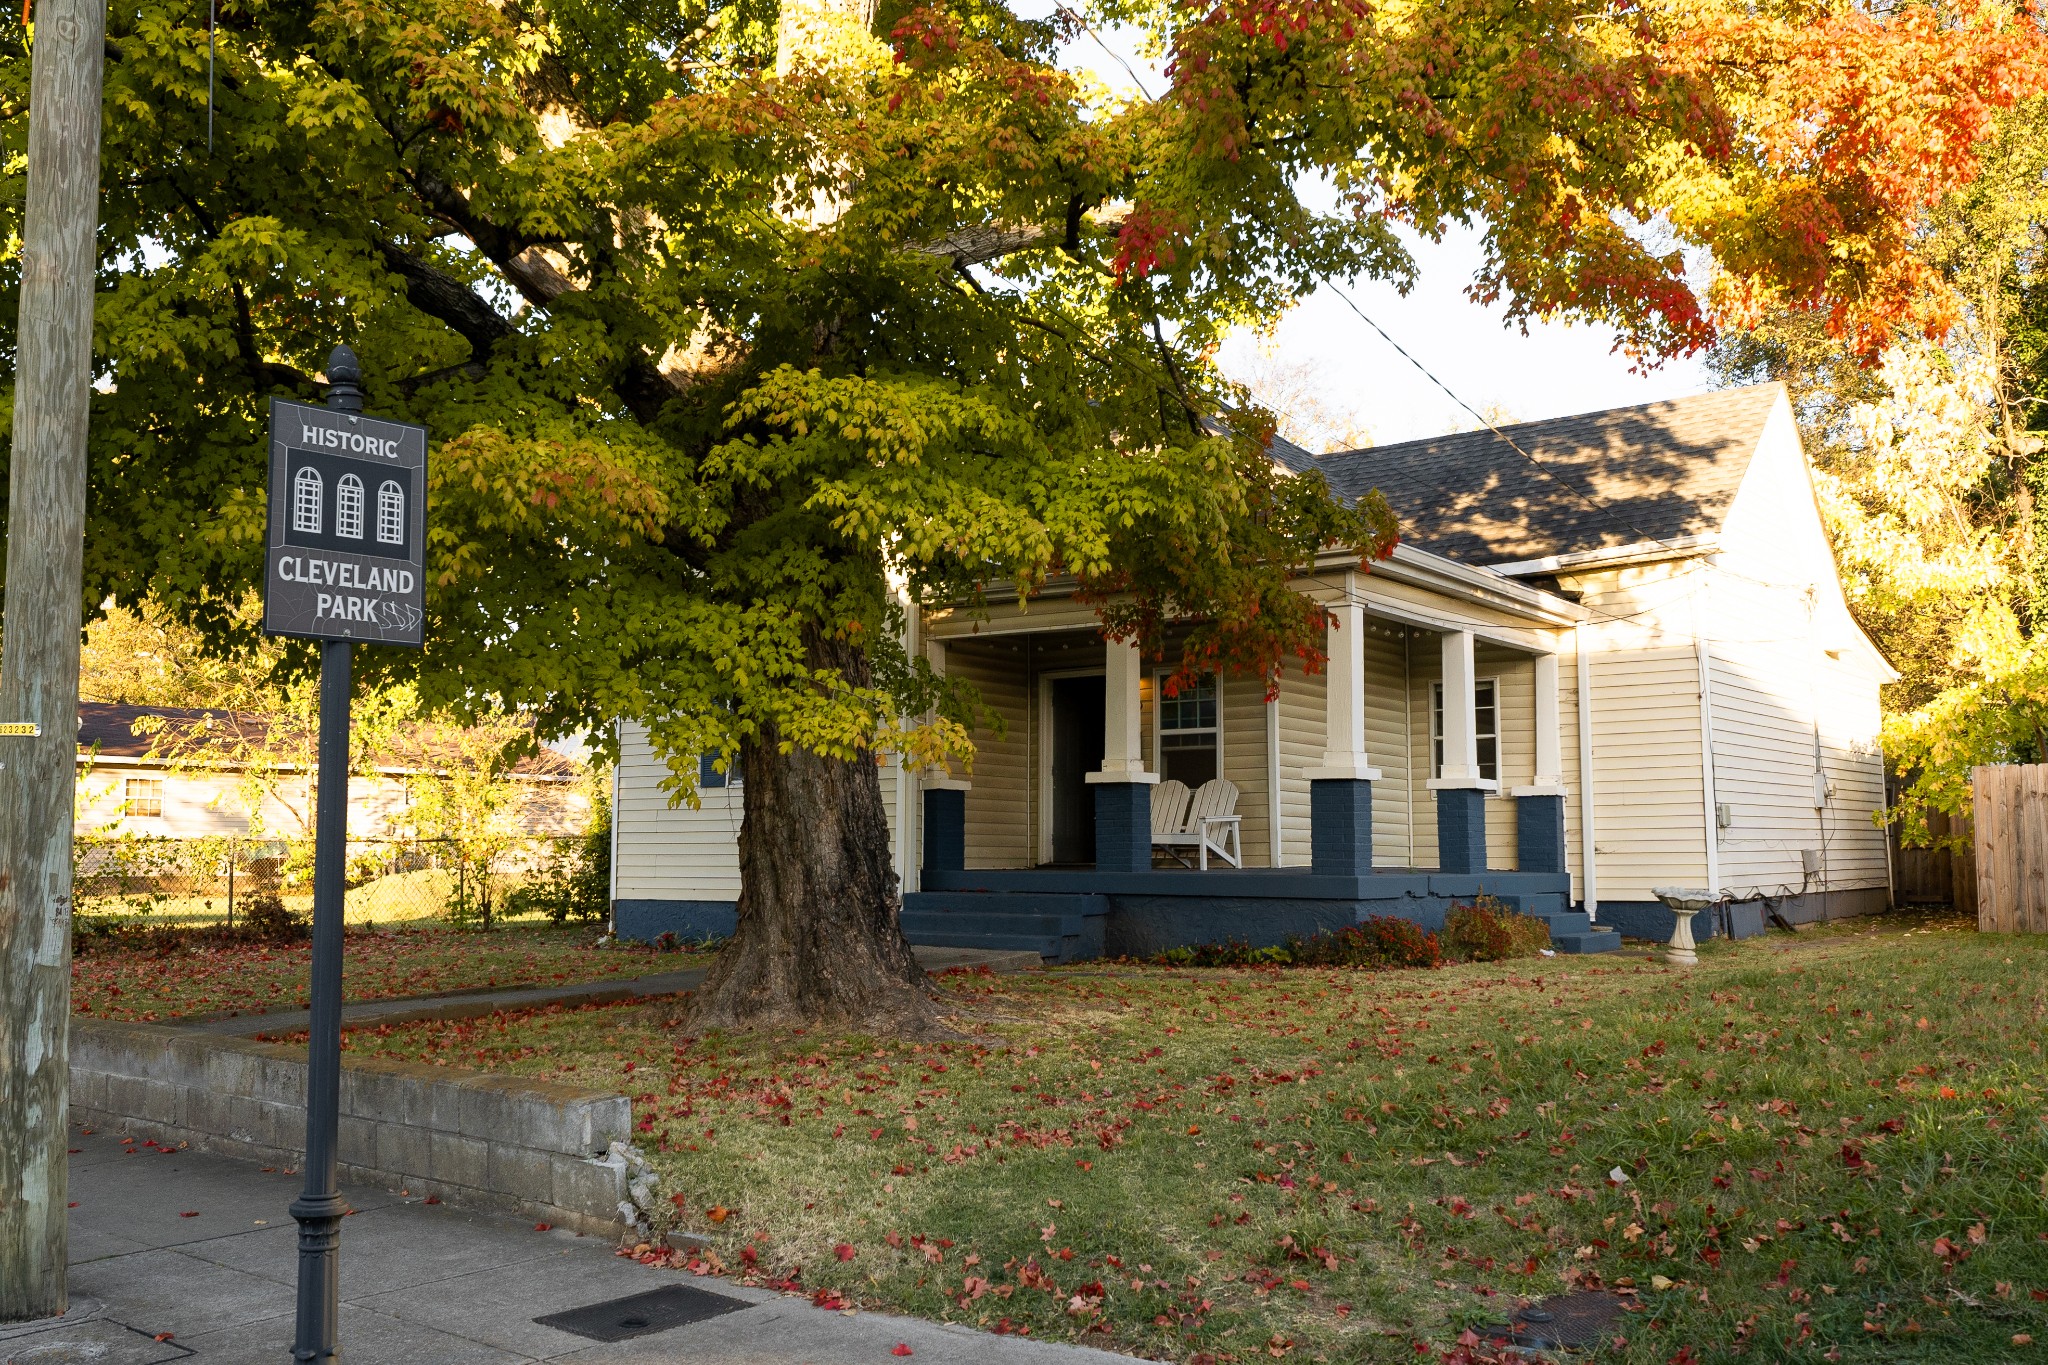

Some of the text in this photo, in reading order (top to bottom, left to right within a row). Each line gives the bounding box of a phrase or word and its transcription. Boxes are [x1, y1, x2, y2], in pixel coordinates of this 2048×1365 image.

[302, 424, 399, 459] HISTORIC
[278, 556, 414, 594] CLEVELAND
[316, 593, 379, 623] PARK
